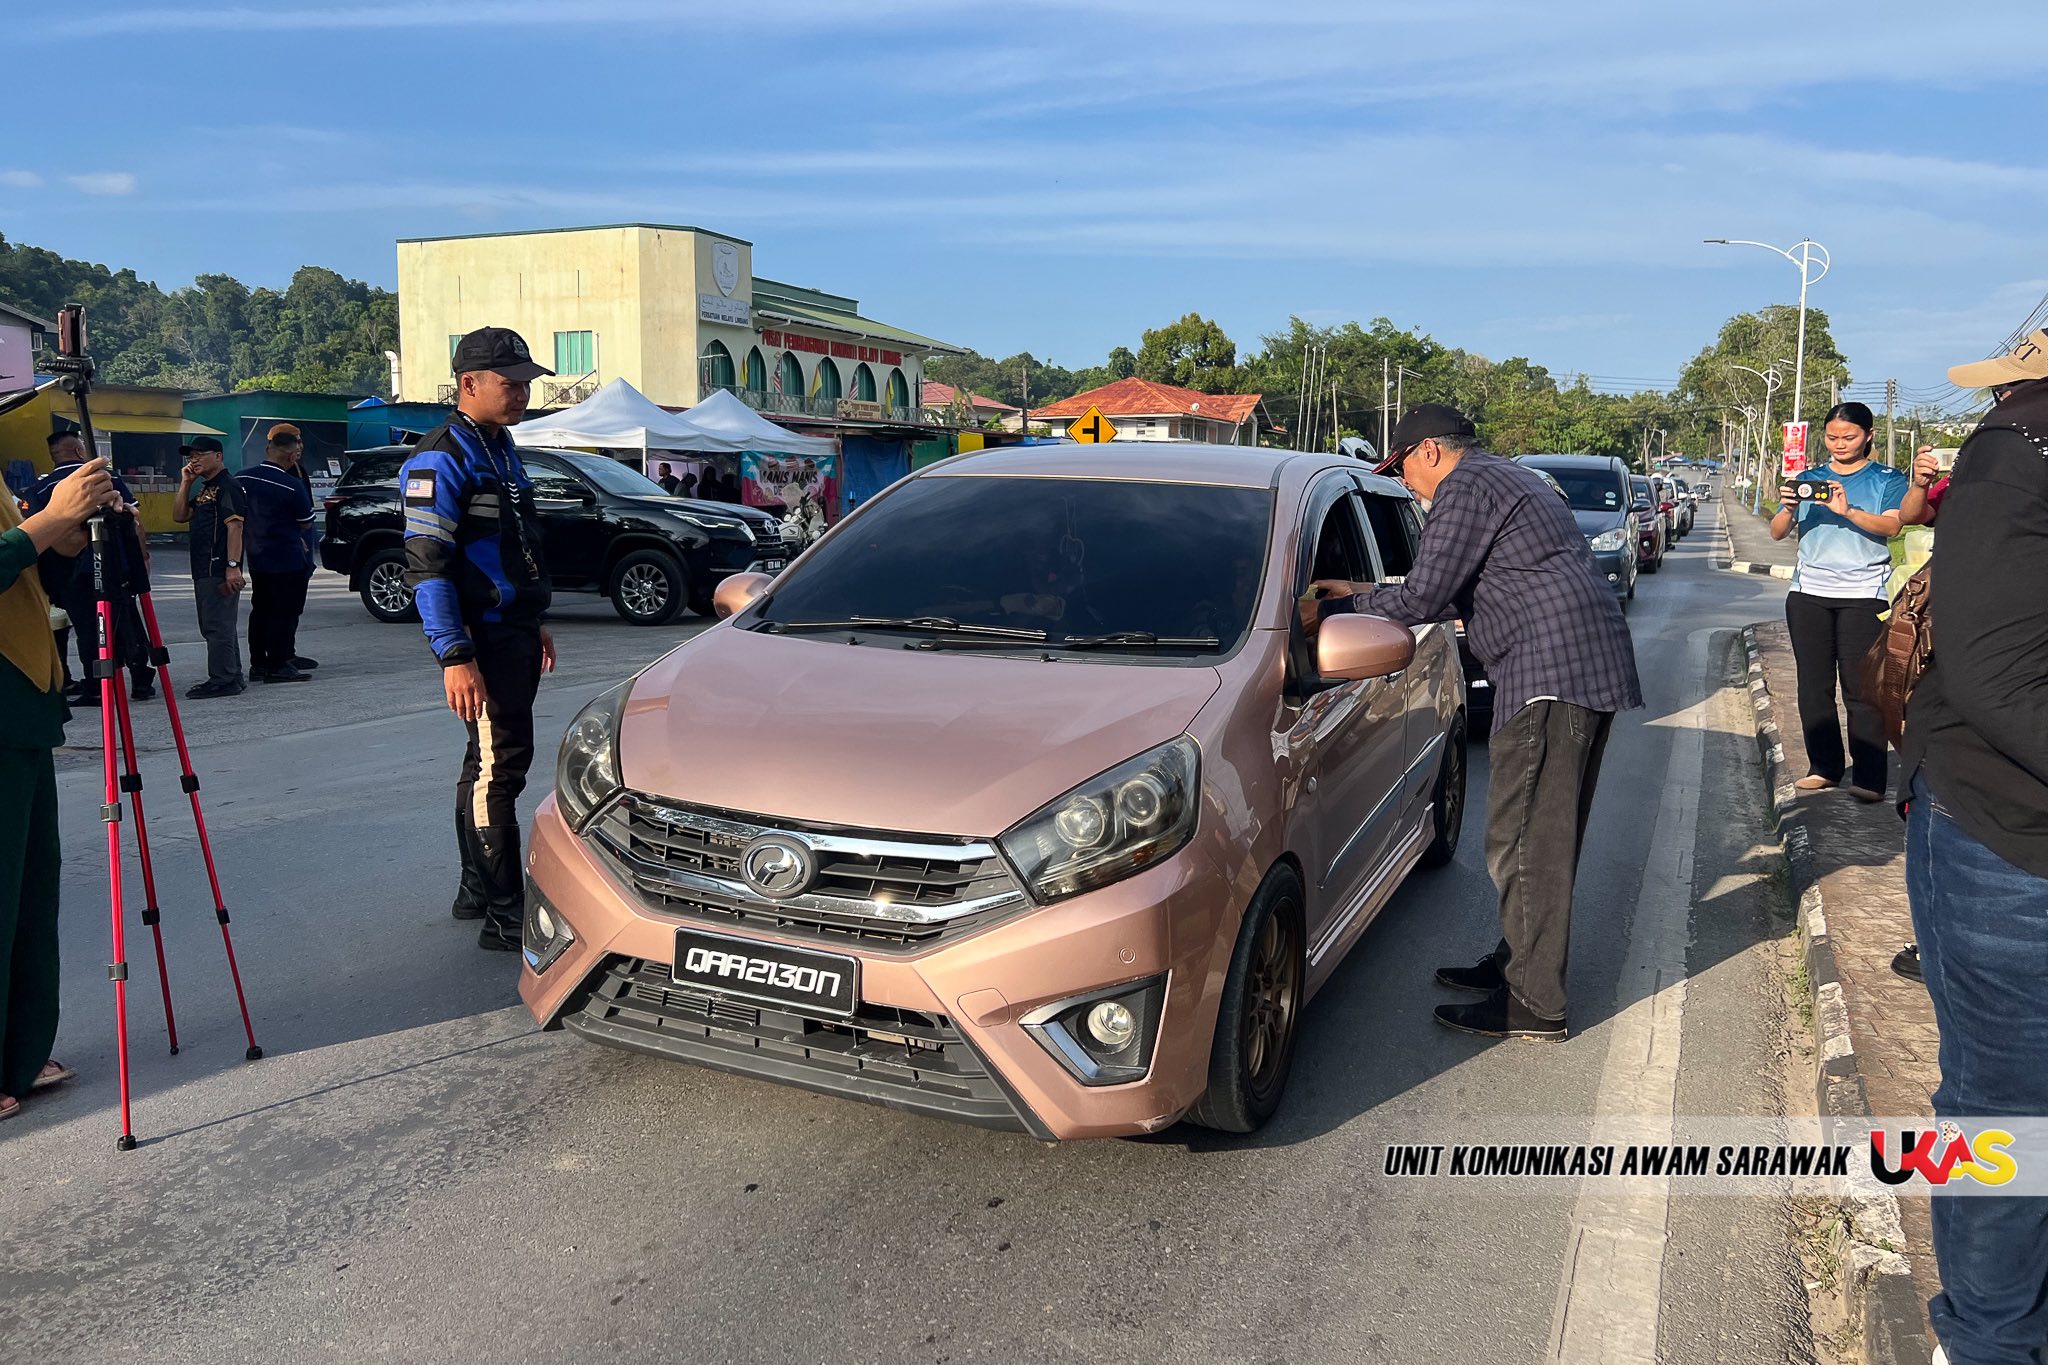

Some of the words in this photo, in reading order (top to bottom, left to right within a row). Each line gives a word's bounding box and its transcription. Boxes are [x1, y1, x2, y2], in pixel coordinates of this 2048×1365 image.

[762, 329, 782, 347] PUSAT
[760, 470, 789, 484] MANIS
[791, 471, 818, 484] MANIS
